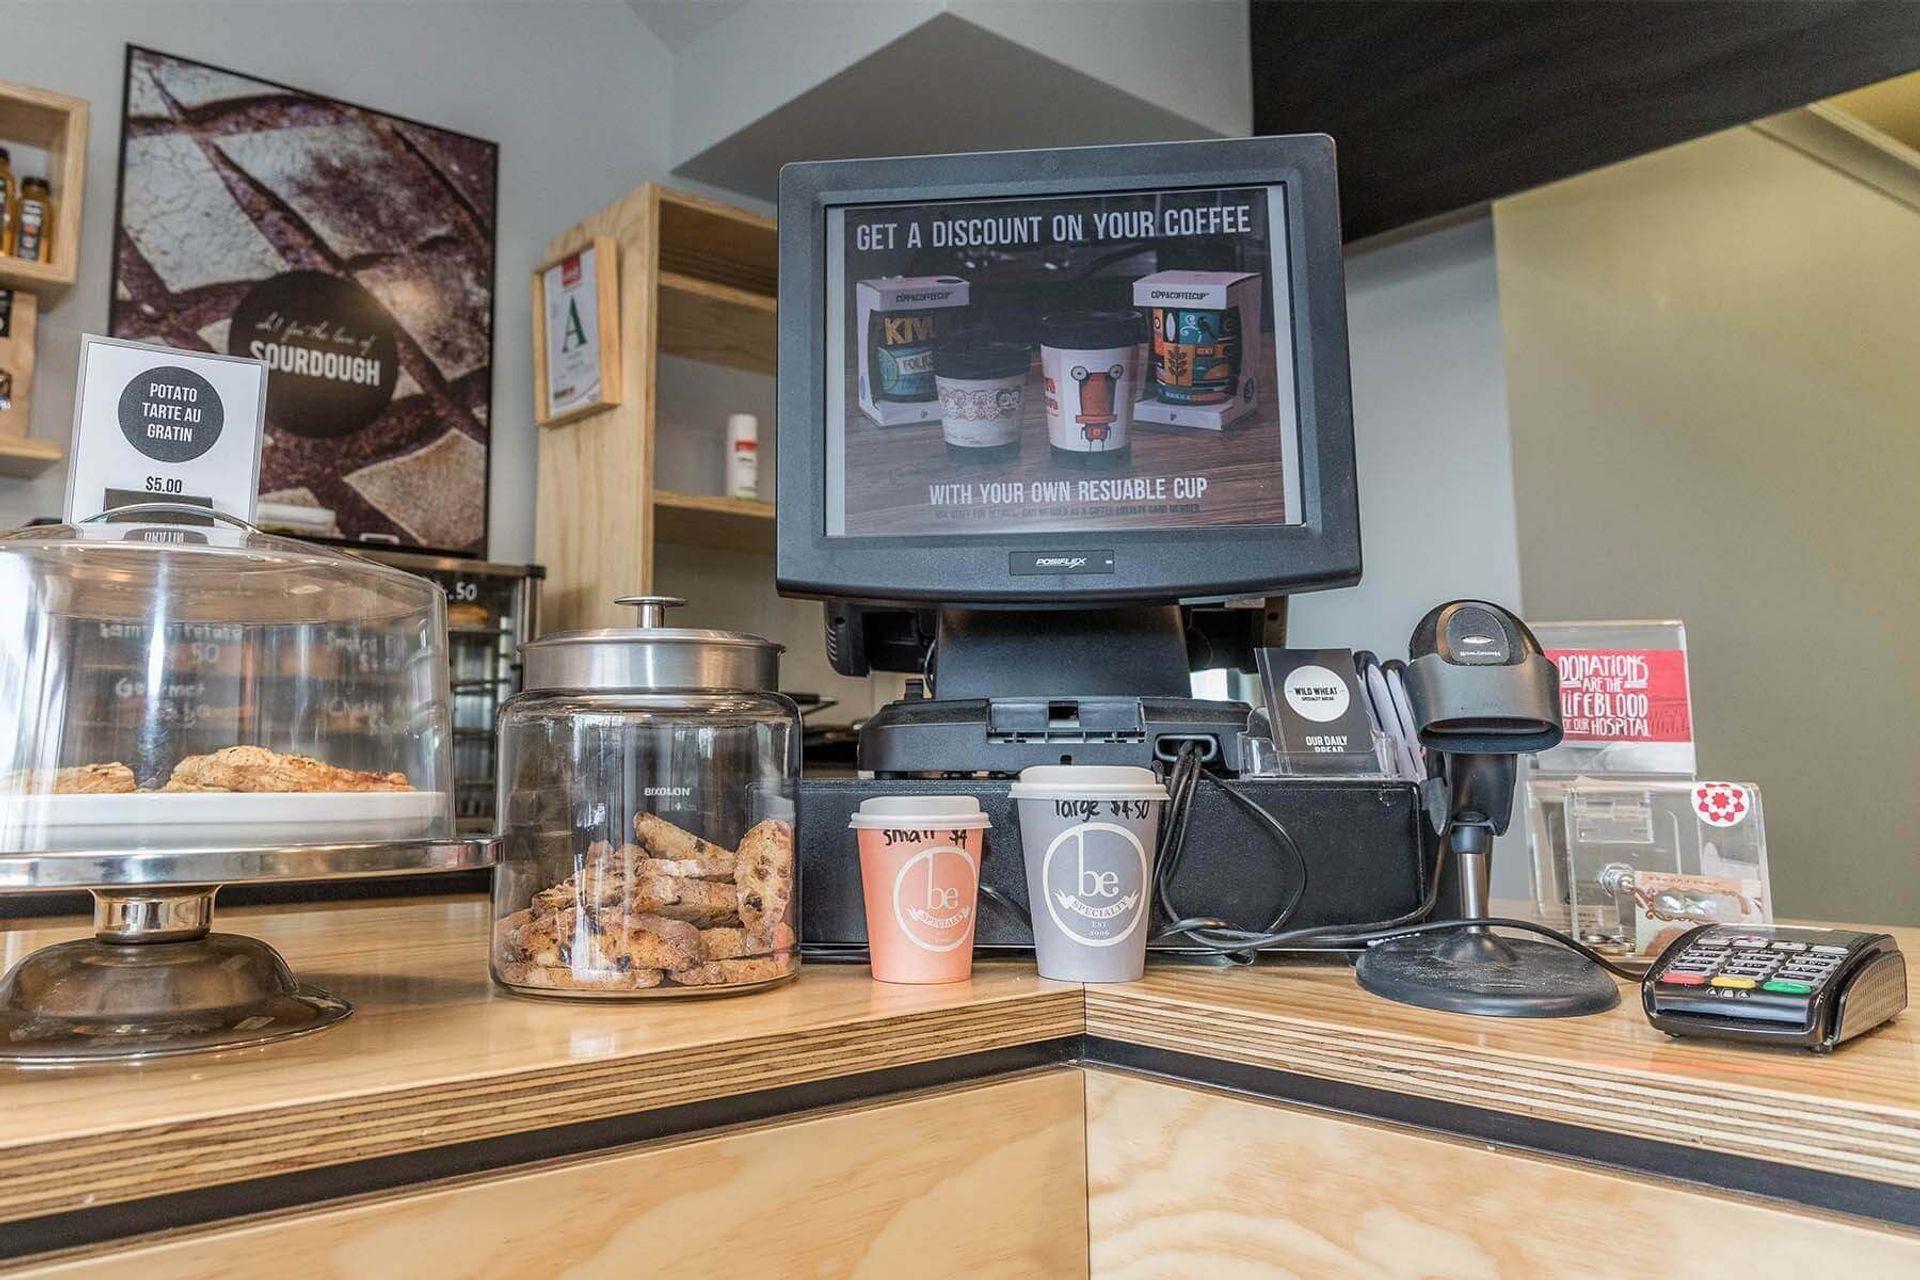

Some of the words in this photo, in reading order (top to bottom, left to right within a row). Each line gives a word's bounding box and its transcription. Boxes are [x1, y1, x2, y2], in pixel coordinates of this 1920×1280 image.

[857, 224, 897, 251] GET
[907, 222, 921, 248] A
[933, 216, 1042, 247] DISCOUNT
[1053, 214, 1083, 242] ON
[1094, 211, 1155, 240] YOUR
[1164, 205, 1251, 236] COFFEE
[562, 295, 588, 353] A
[250, 340, 381, 387] SOURDOUGH
[150, 382, 198, 403] POTATO
[142, 402, 183, 421] TARTE
[184, 408, 201, 423] AU
[147, 423, 193, 442] GRATIN
[145, 476, 183, 494] $5.00
[929, 484, 972, 505] WITH
[979, 482, 1024, 504] YOUR
[1031, 481, 1070, 503] OWN
[1079, 479, 1166, 501] RESUABLE
[1173, 477, 1207, 499] CUP
[1559, 654, 1649, 682] DONATIONS
[1294, 688, 1312, 696] WILD
[1313, 687, 1338, 696] WHEAT
[1582, 678, 1603, 693] ARE
[1605, 677, 1624, 692] THE
[1561, 690, 1648, 718] LIFEBLOOD
[1591, 717, 1652, 737] HOSPITAL
[1305, 736, 1324, 746] OUR
[1325, 736, 1348, 746] DAILY
